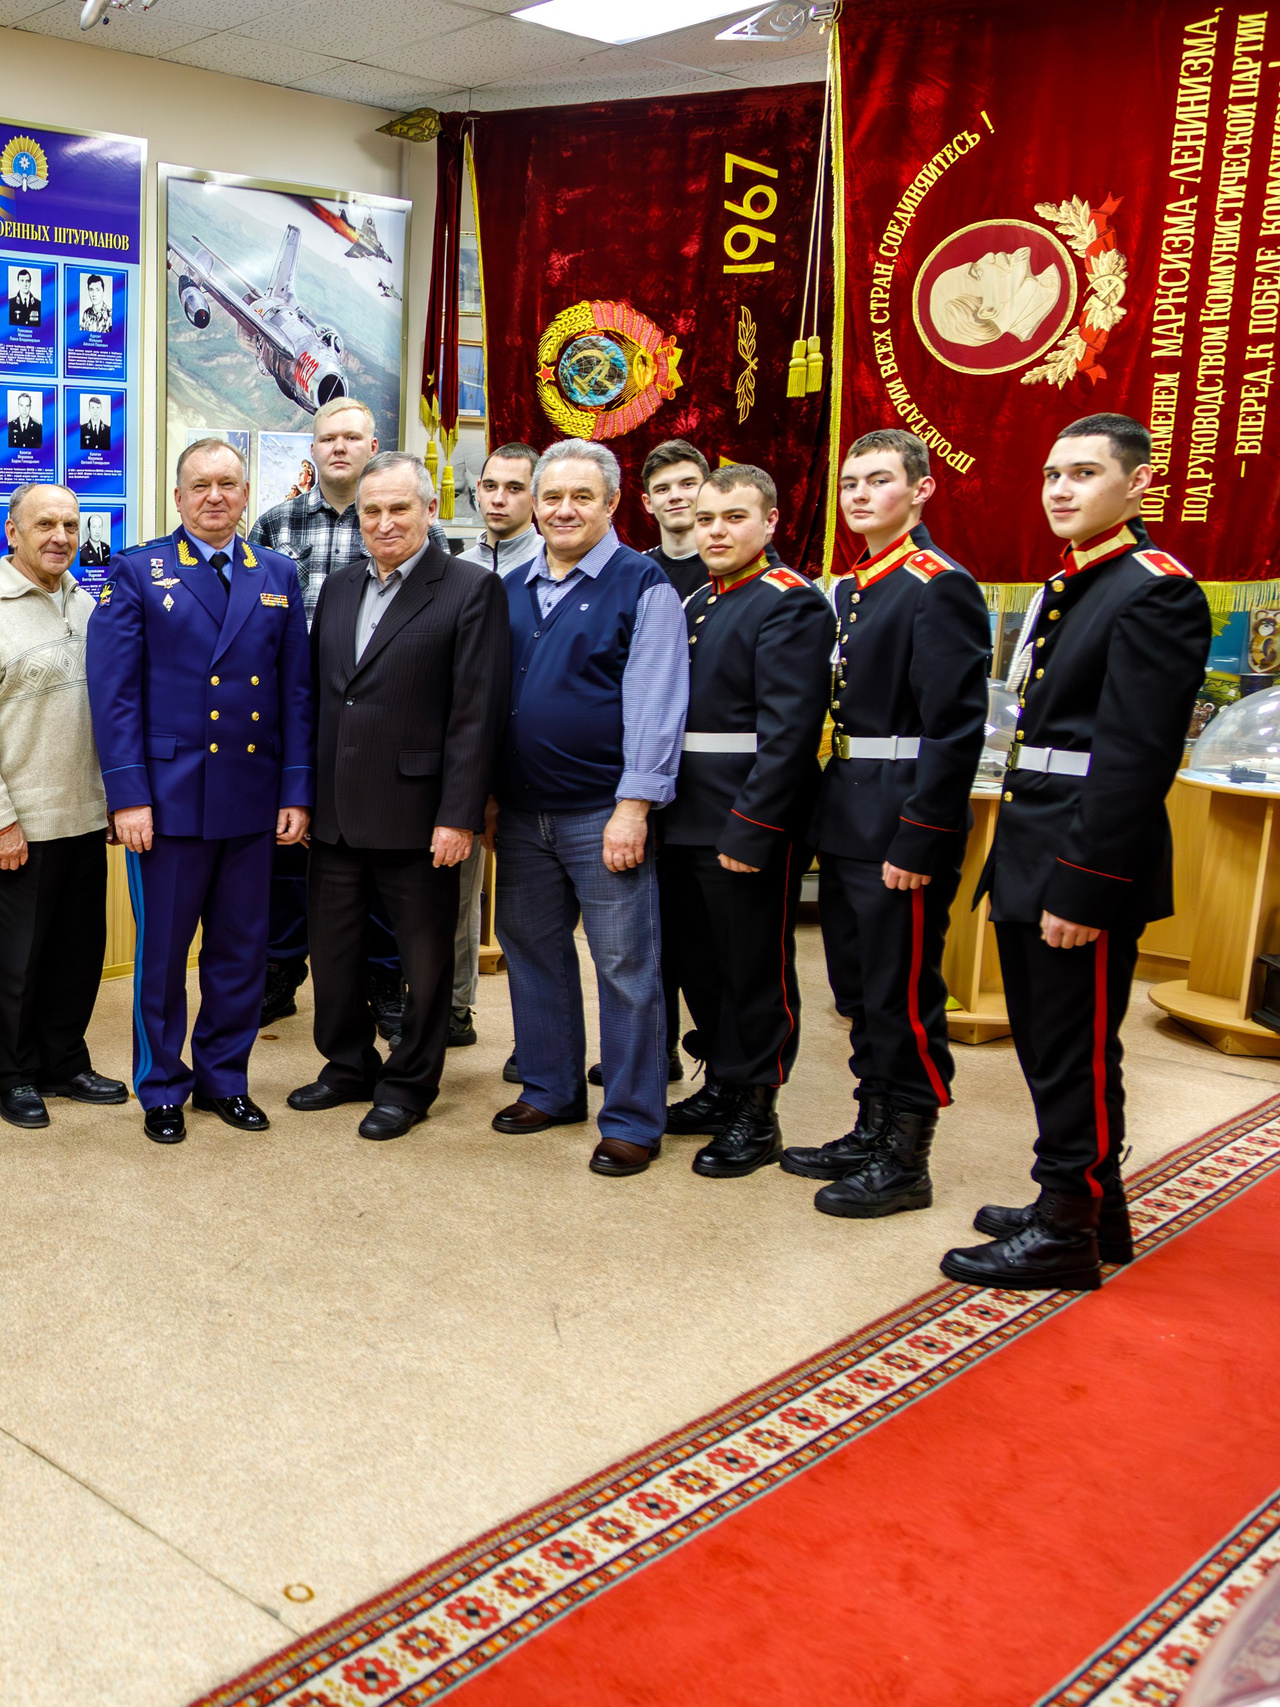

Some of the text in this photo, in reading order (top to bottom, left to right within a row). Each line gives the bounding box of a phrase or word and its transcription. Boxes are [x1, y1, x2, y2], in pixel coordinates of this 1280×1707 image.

[54, 226, 130, 251] ШТУРМАНОВ
[723, 152, 779, 274] 1967
[1181, 11, 1268, 523] ПОД РУКОВОДСТВОМ КОММУНИСТИЧЕСКОЙ ПАРТИИ
[872, 329, 898, 379] ВСЕХ
[885, 377, 976, 474] ПРОЛЕТАРИИ
[1150, 371, 1180, 476] ЗНАМЕНЕМ
